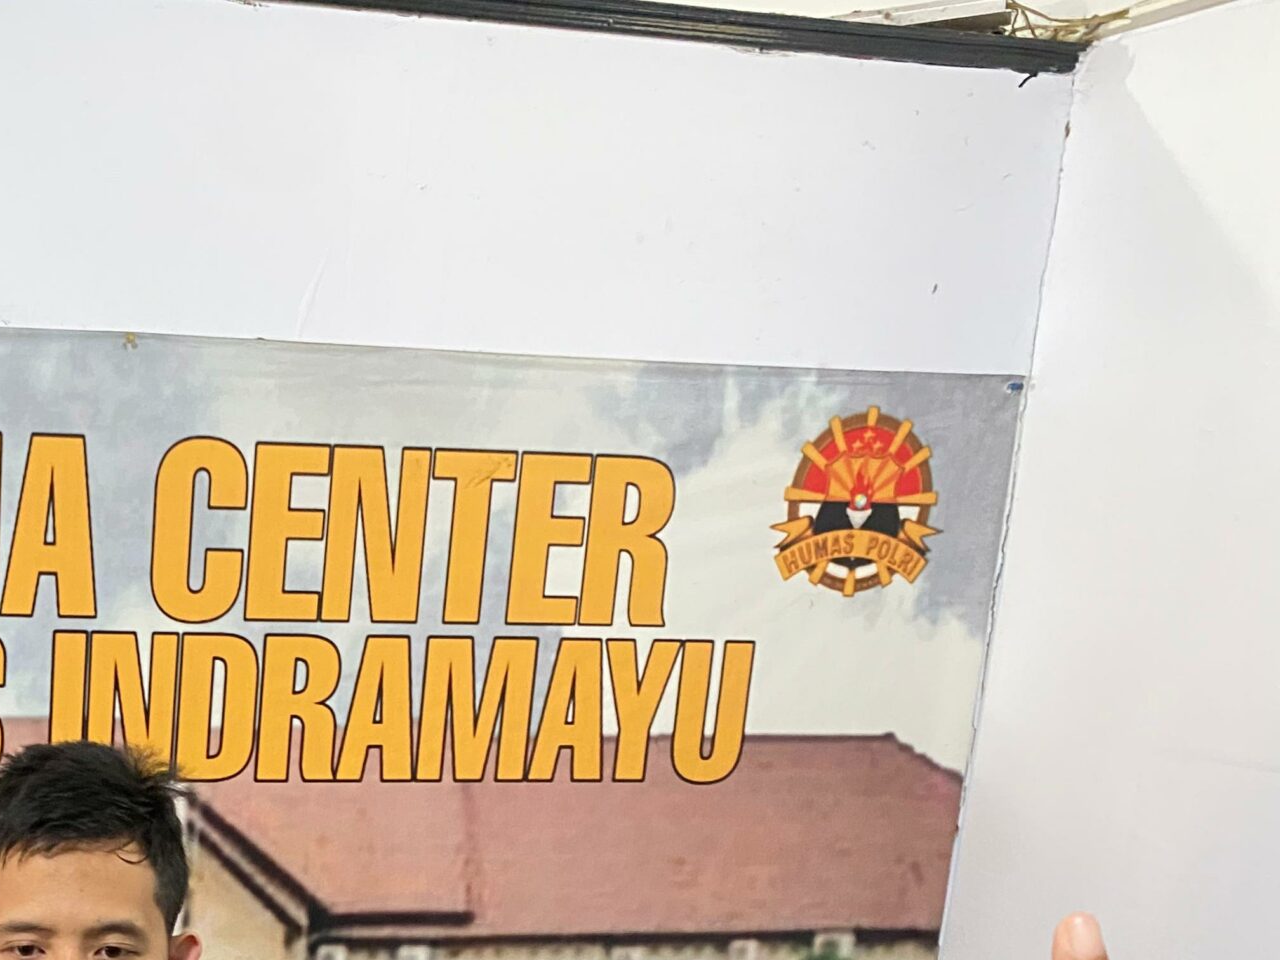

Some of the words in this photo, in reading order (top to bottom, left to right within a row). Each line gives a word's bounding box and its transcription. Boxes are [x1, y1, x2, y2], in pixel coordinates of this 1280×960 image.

[150, 436, 676, 628] CENTER
[782, 532, 855, 574] HUMAS
[866, 535, 921, 576] POLRI
[48, 630, 756, 785] INDRAMAYU
